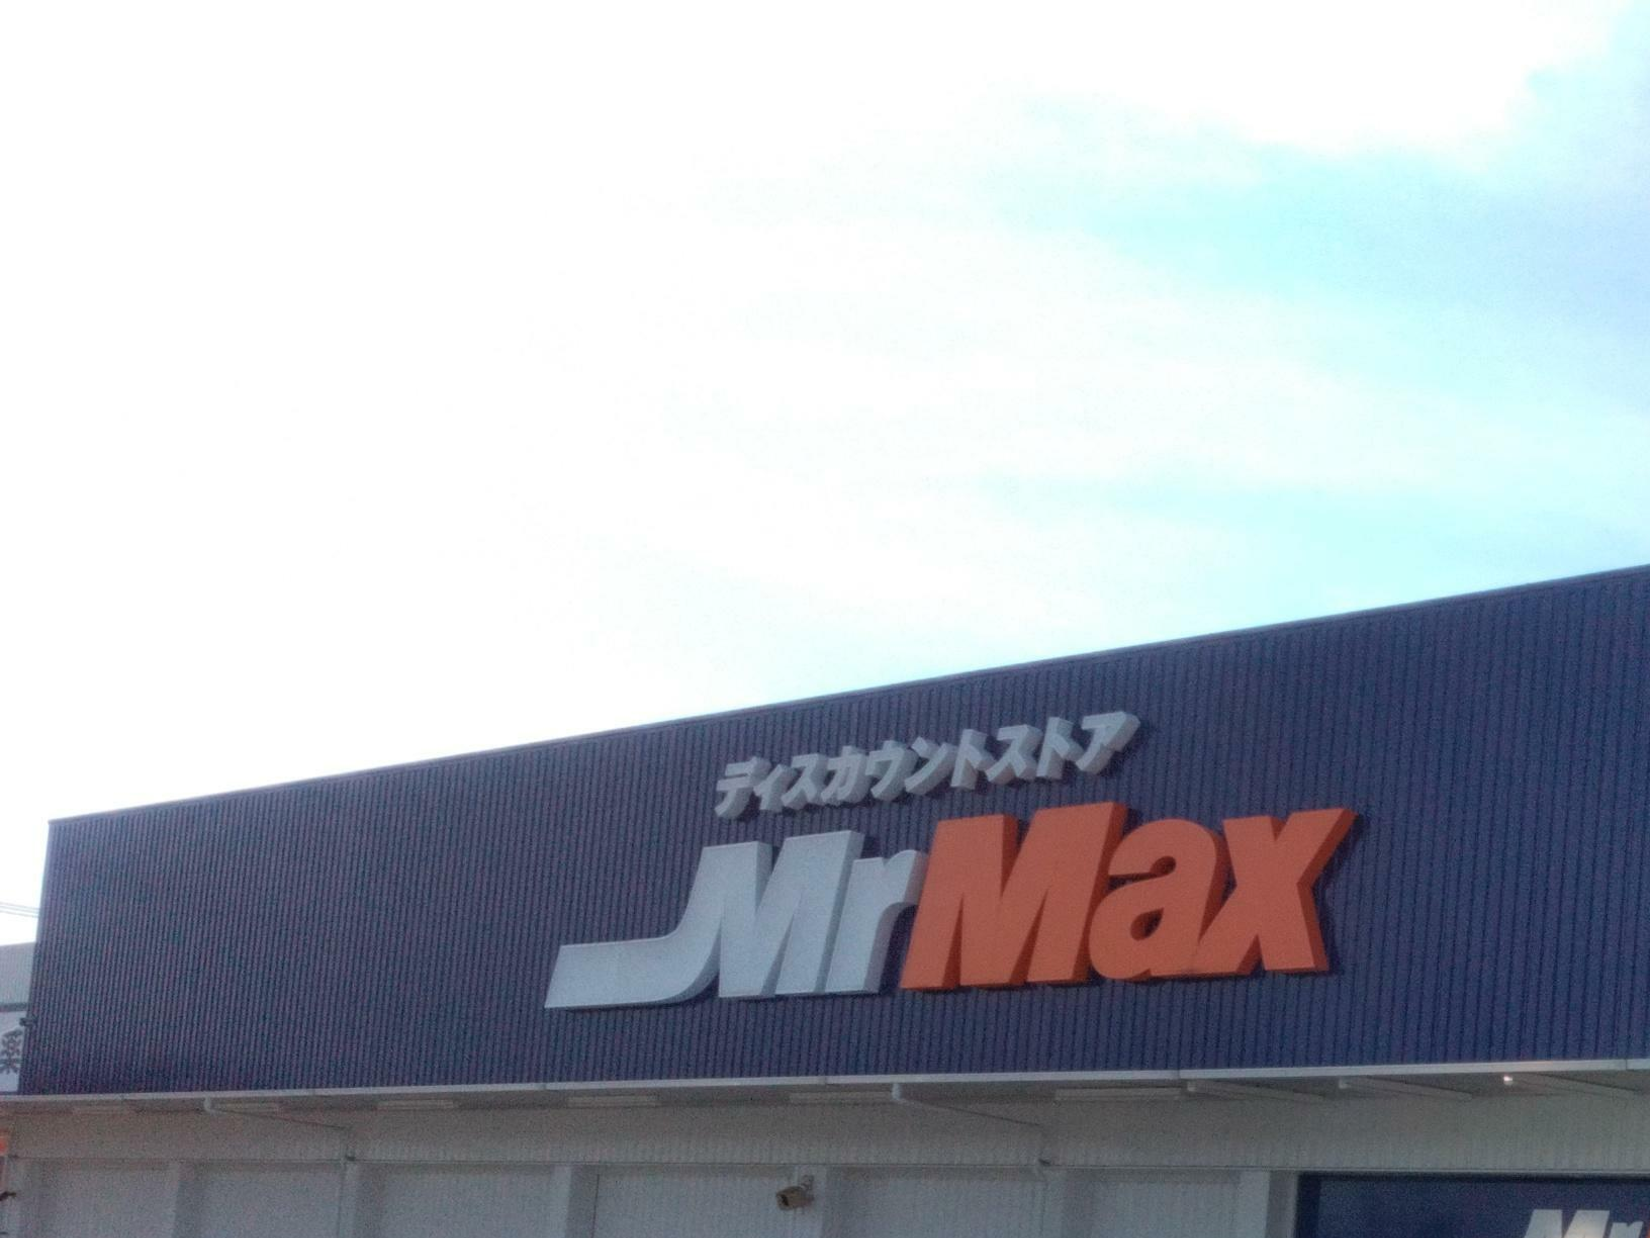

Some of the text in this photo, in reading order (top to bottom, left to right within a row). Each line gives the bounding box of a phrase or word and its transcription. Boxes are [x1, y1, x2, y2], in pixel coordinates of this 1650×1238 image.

[714, 711, 1141, 819] ディスカウントストア
[545, 801, 1358, 1009] MrMax
